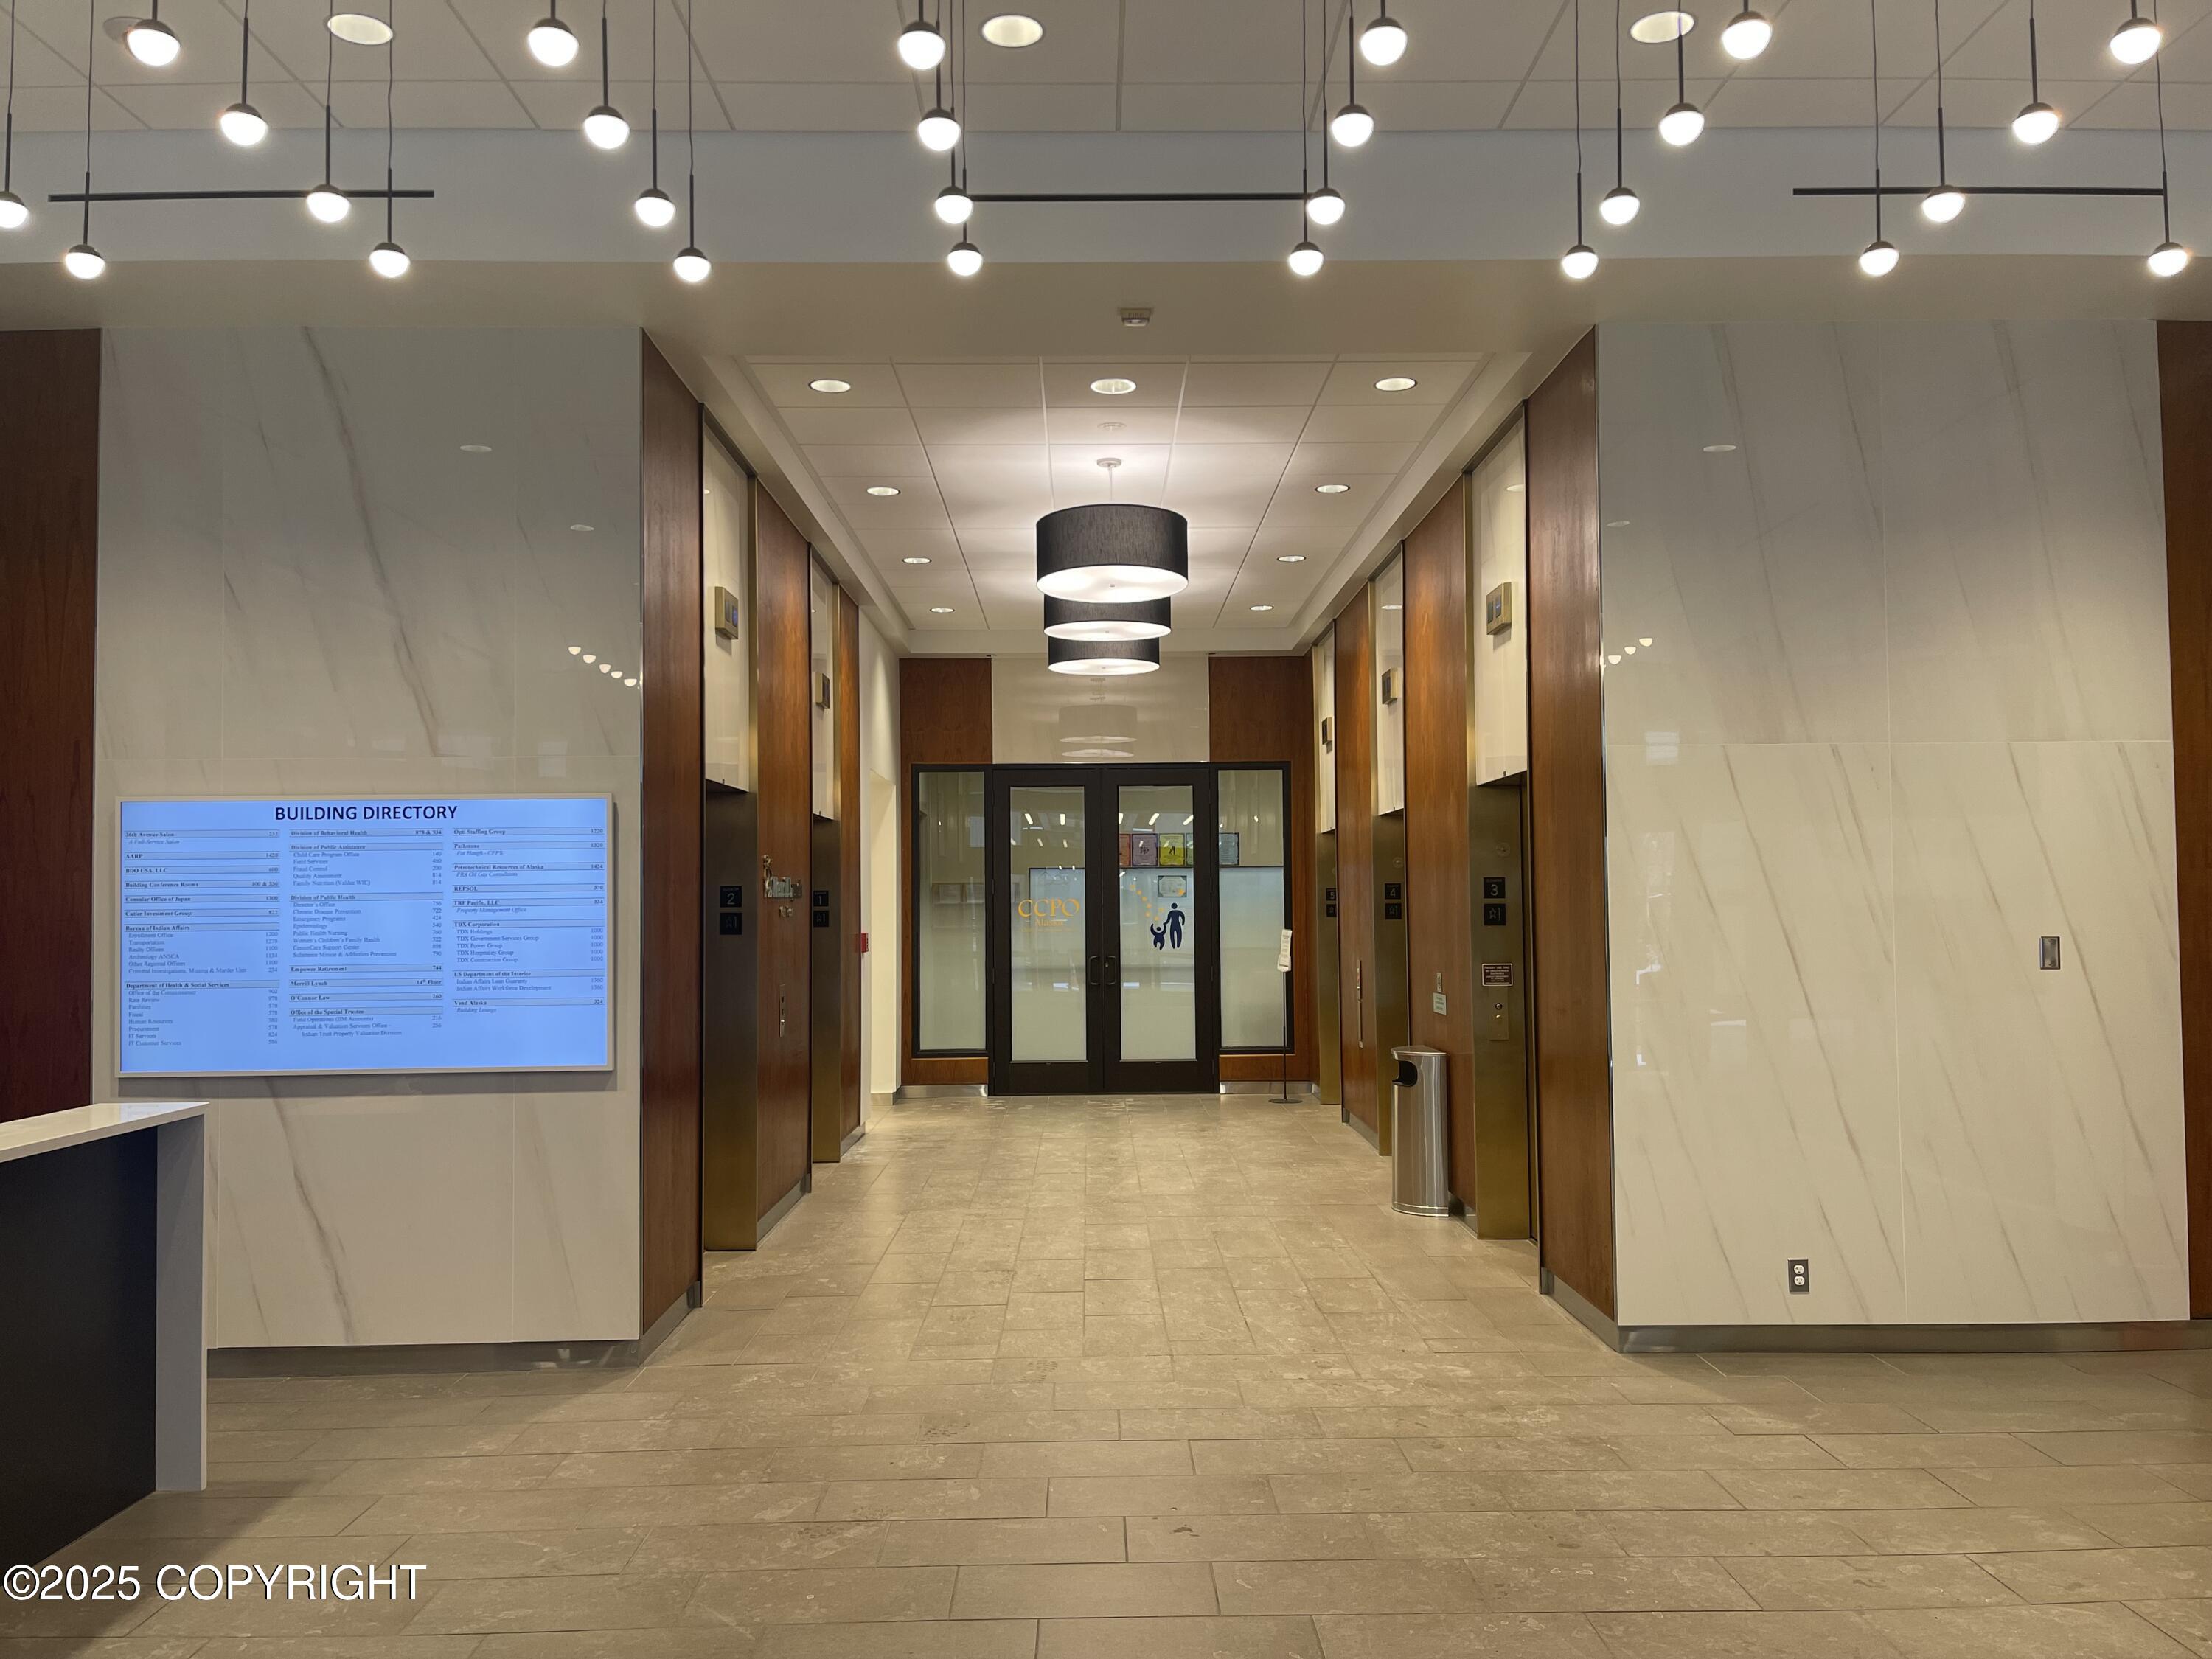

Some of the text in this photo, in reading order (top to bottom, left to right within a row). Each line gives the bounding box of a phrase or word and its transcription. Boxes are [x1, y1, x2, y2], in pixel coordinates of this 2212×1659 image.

[275, 806, 458, 820] BUILDING DIRECTORY
[1390, 888, 1396, 897] 4
[1491, 884, 1498, 896] 3
[726, 893, 735, 905] 2
[1018, 899, 1080, 918] CCPO
